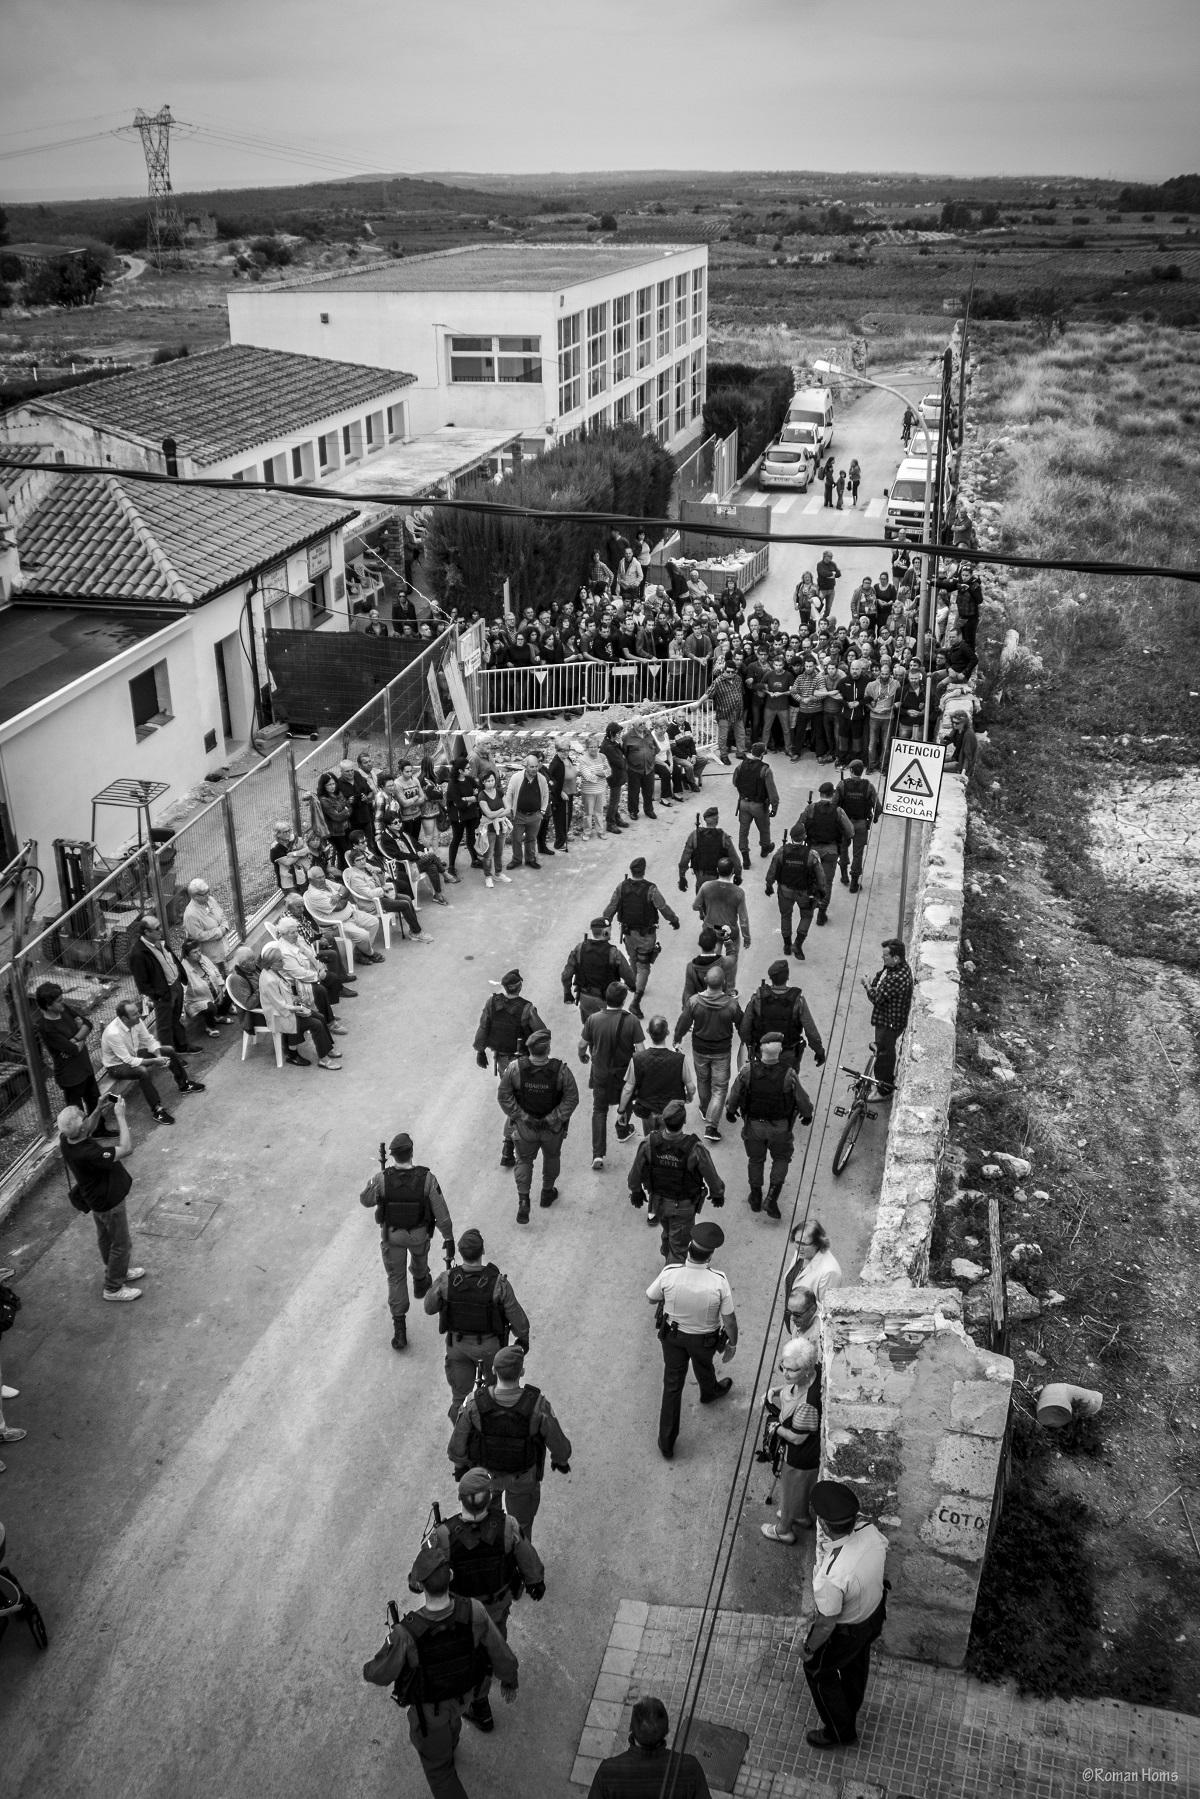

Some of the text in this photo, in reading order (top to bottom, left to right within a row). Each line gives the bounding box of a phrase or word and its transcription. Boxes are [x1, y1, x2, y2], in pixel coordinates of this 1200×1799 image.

[894, 743, 941, 759] ATENCIÓ
[896, 795, 924, 807] ZONA
[885, 803, 933, 818] ESCOLAR
[660, 1159, 679, 1168] CIVIL
[938, 1508, 985, 1531] COTO
